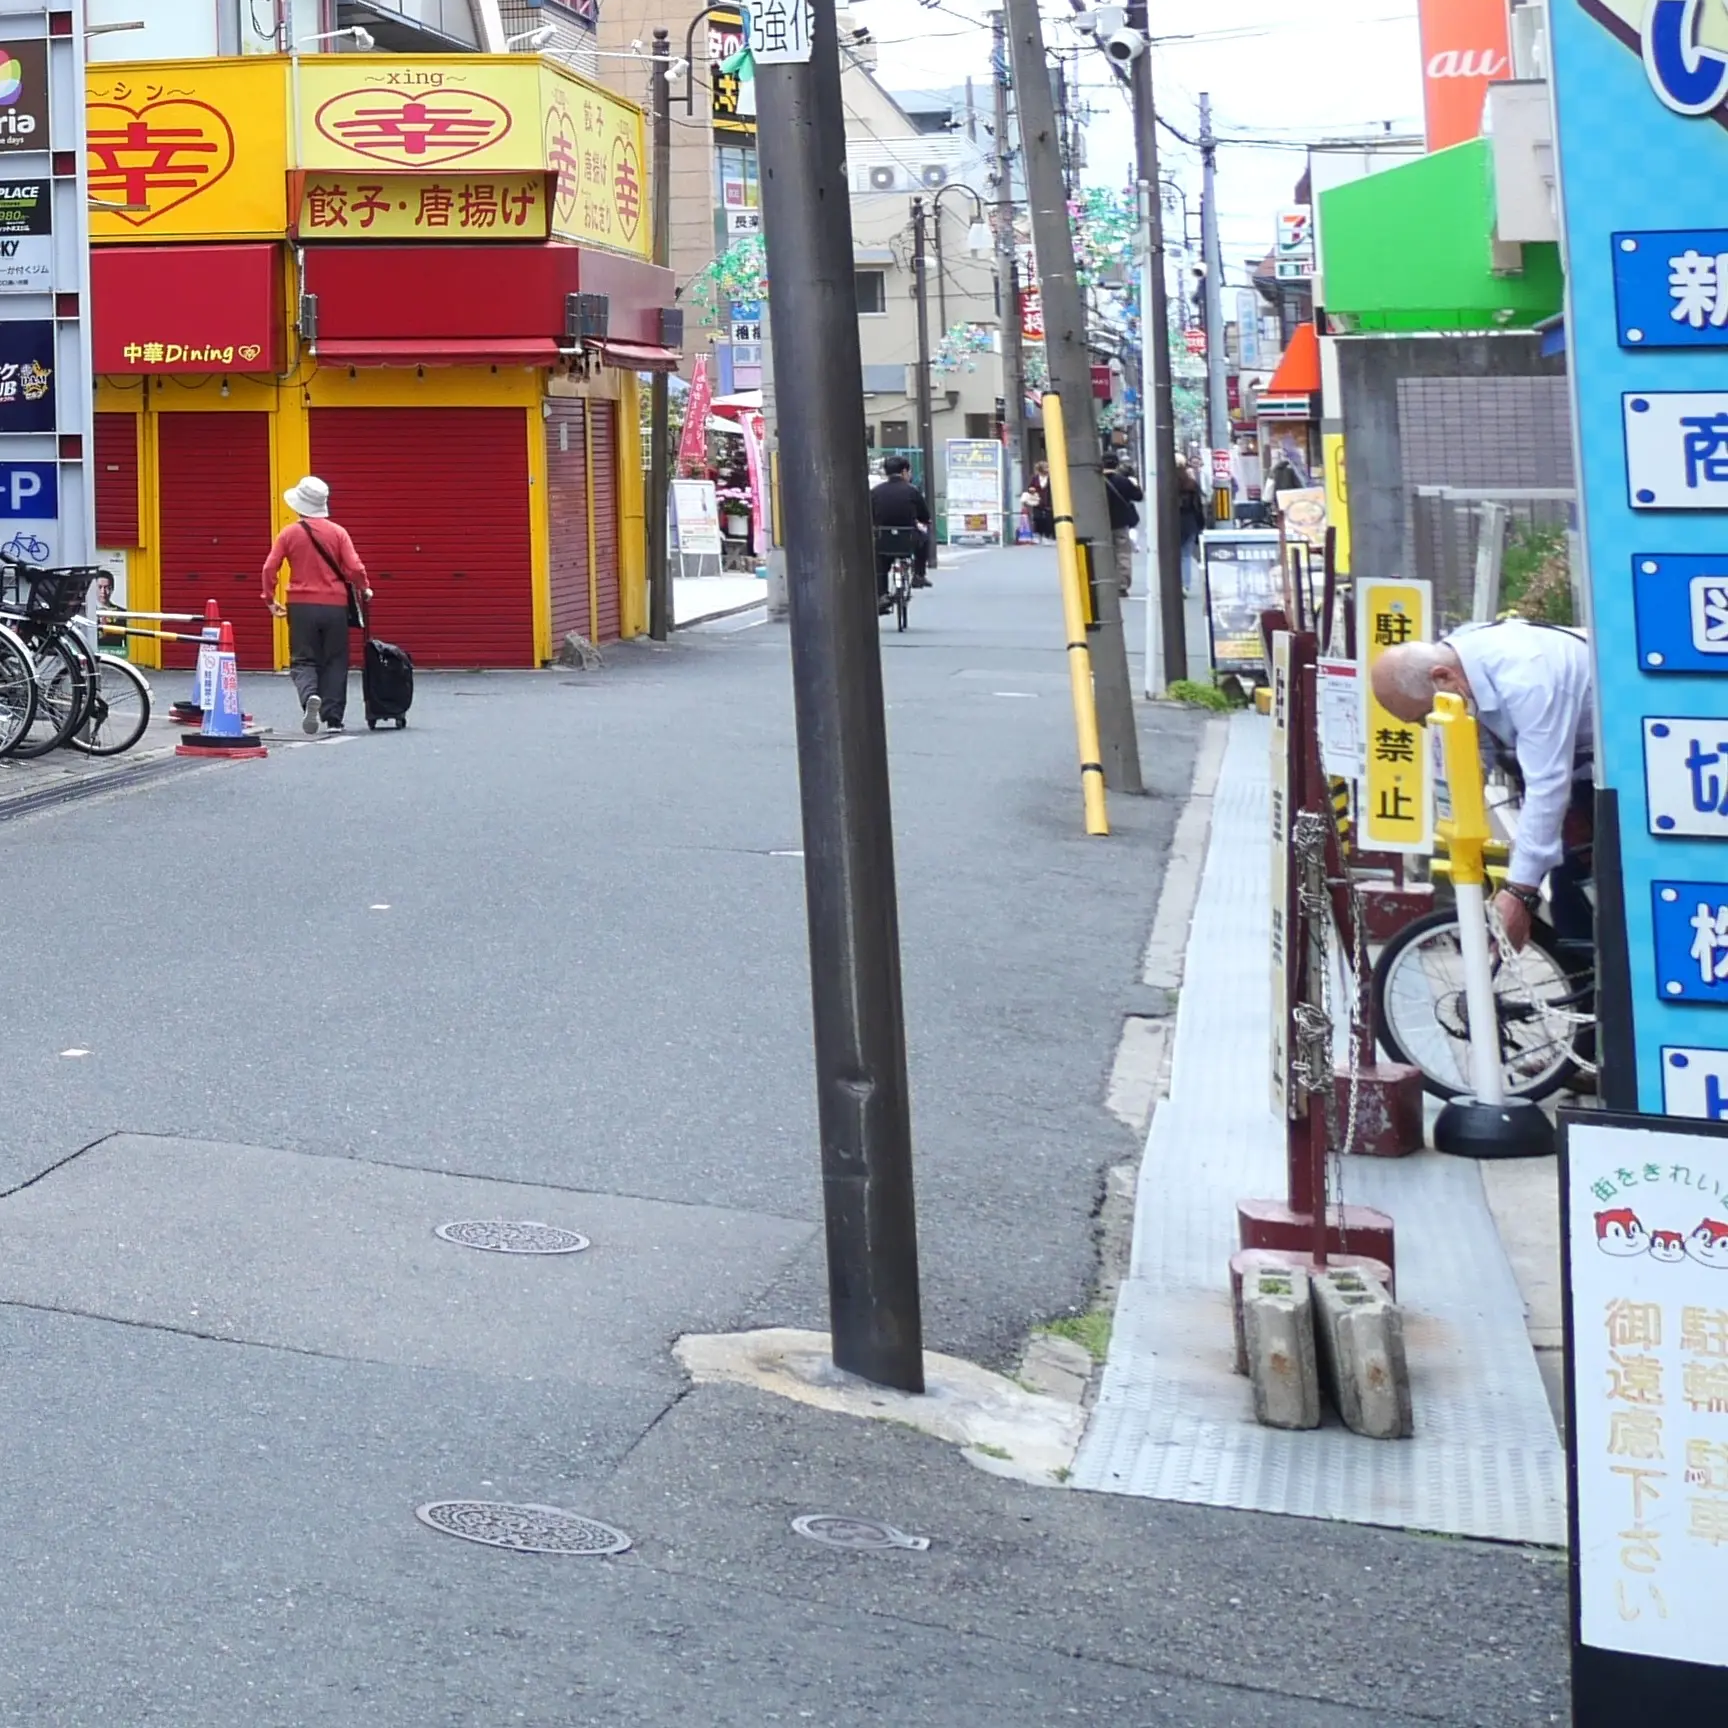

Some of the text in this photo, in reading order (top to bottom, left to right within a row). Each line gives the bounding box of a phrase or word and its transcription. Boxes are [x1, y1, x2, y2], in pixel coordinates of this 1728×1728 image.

[1426, 47, 1507, 79] au
[7, 135, 24, 145] days
[306, 179, 539, 230] 餃子・唐揚げ
[123, 341, 234, 365] 中華Dining
[11, 470, 41, 511] P
[1374, 612, 1415, 823] 駐禁止
[1603, 1295, 1671, 1624] 御遠慮下さい
